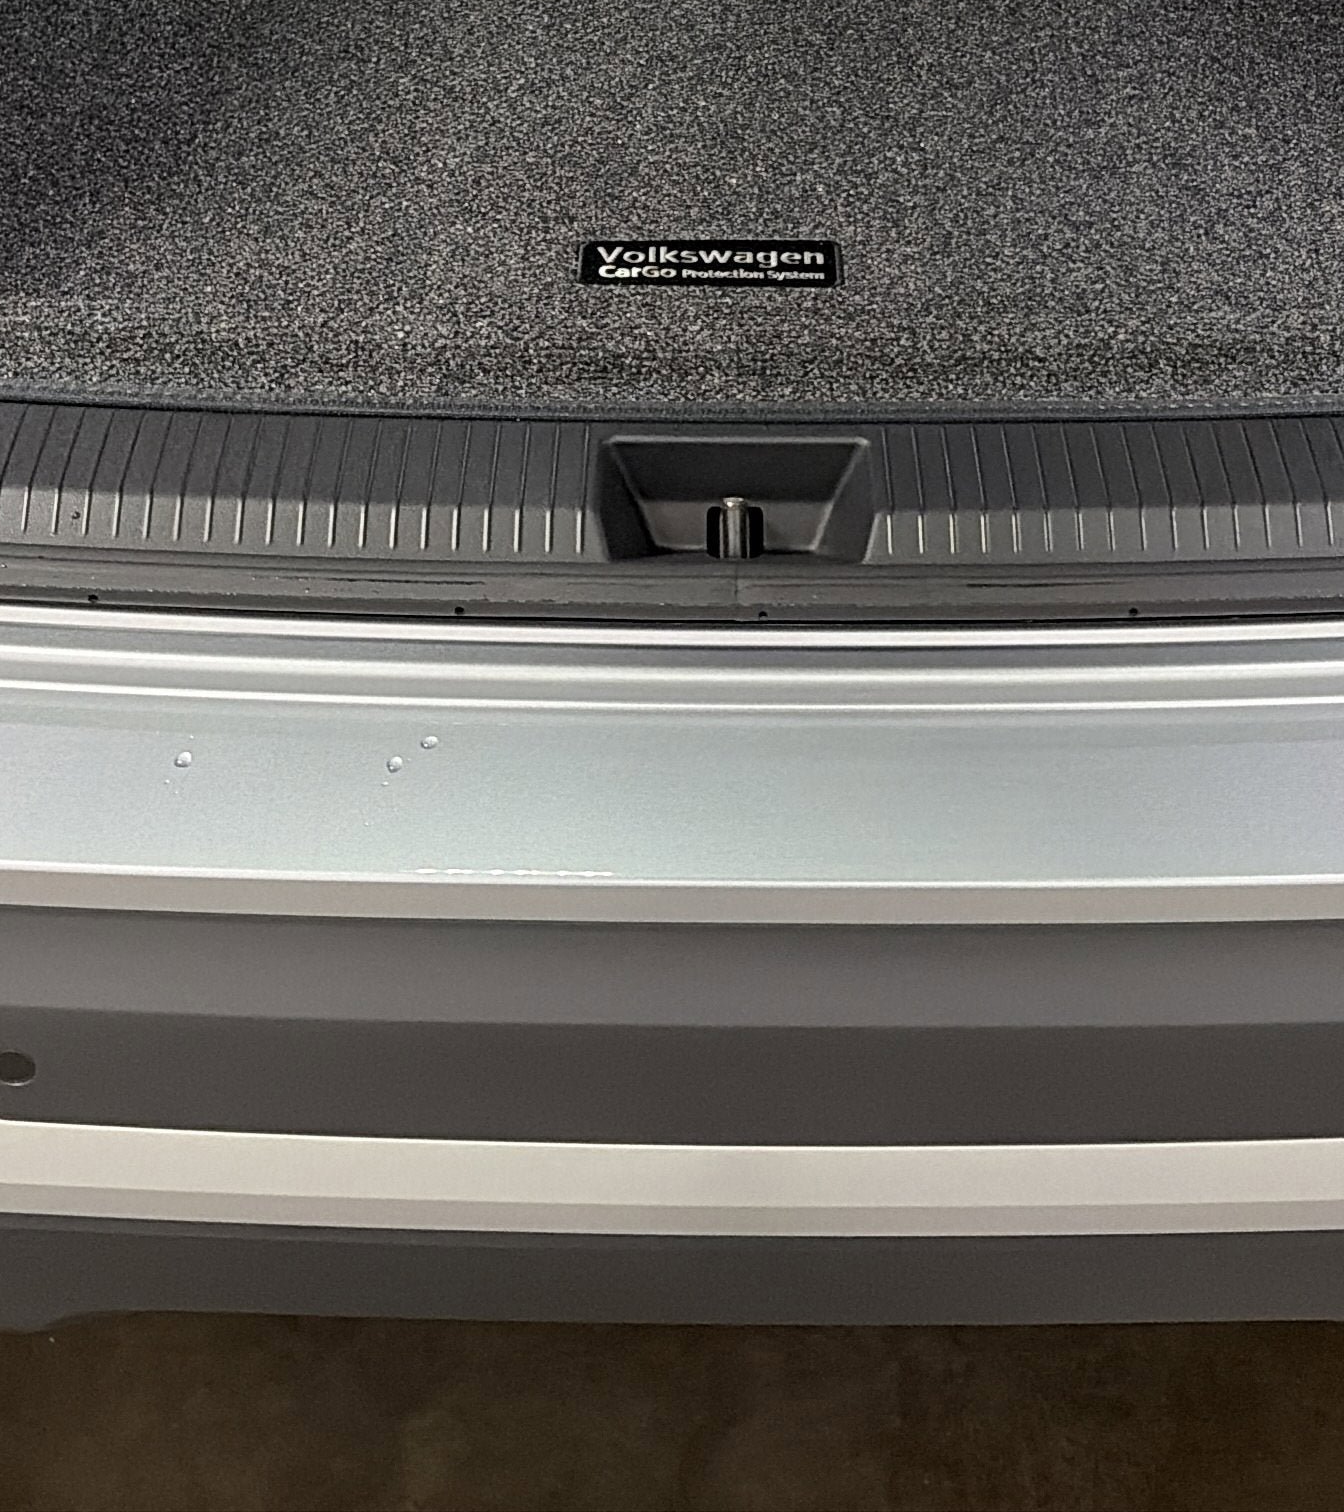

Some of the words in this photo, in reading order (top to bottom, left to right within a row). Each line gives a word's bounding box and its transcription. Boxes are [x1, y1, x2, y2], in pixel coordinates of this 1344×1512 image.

[597, 246, 825, 268] Volkswagen
[598, 265, 677, 279] CarGo
[682, 268, 765, 280] Protection
[767, 270, 825, 280] System
